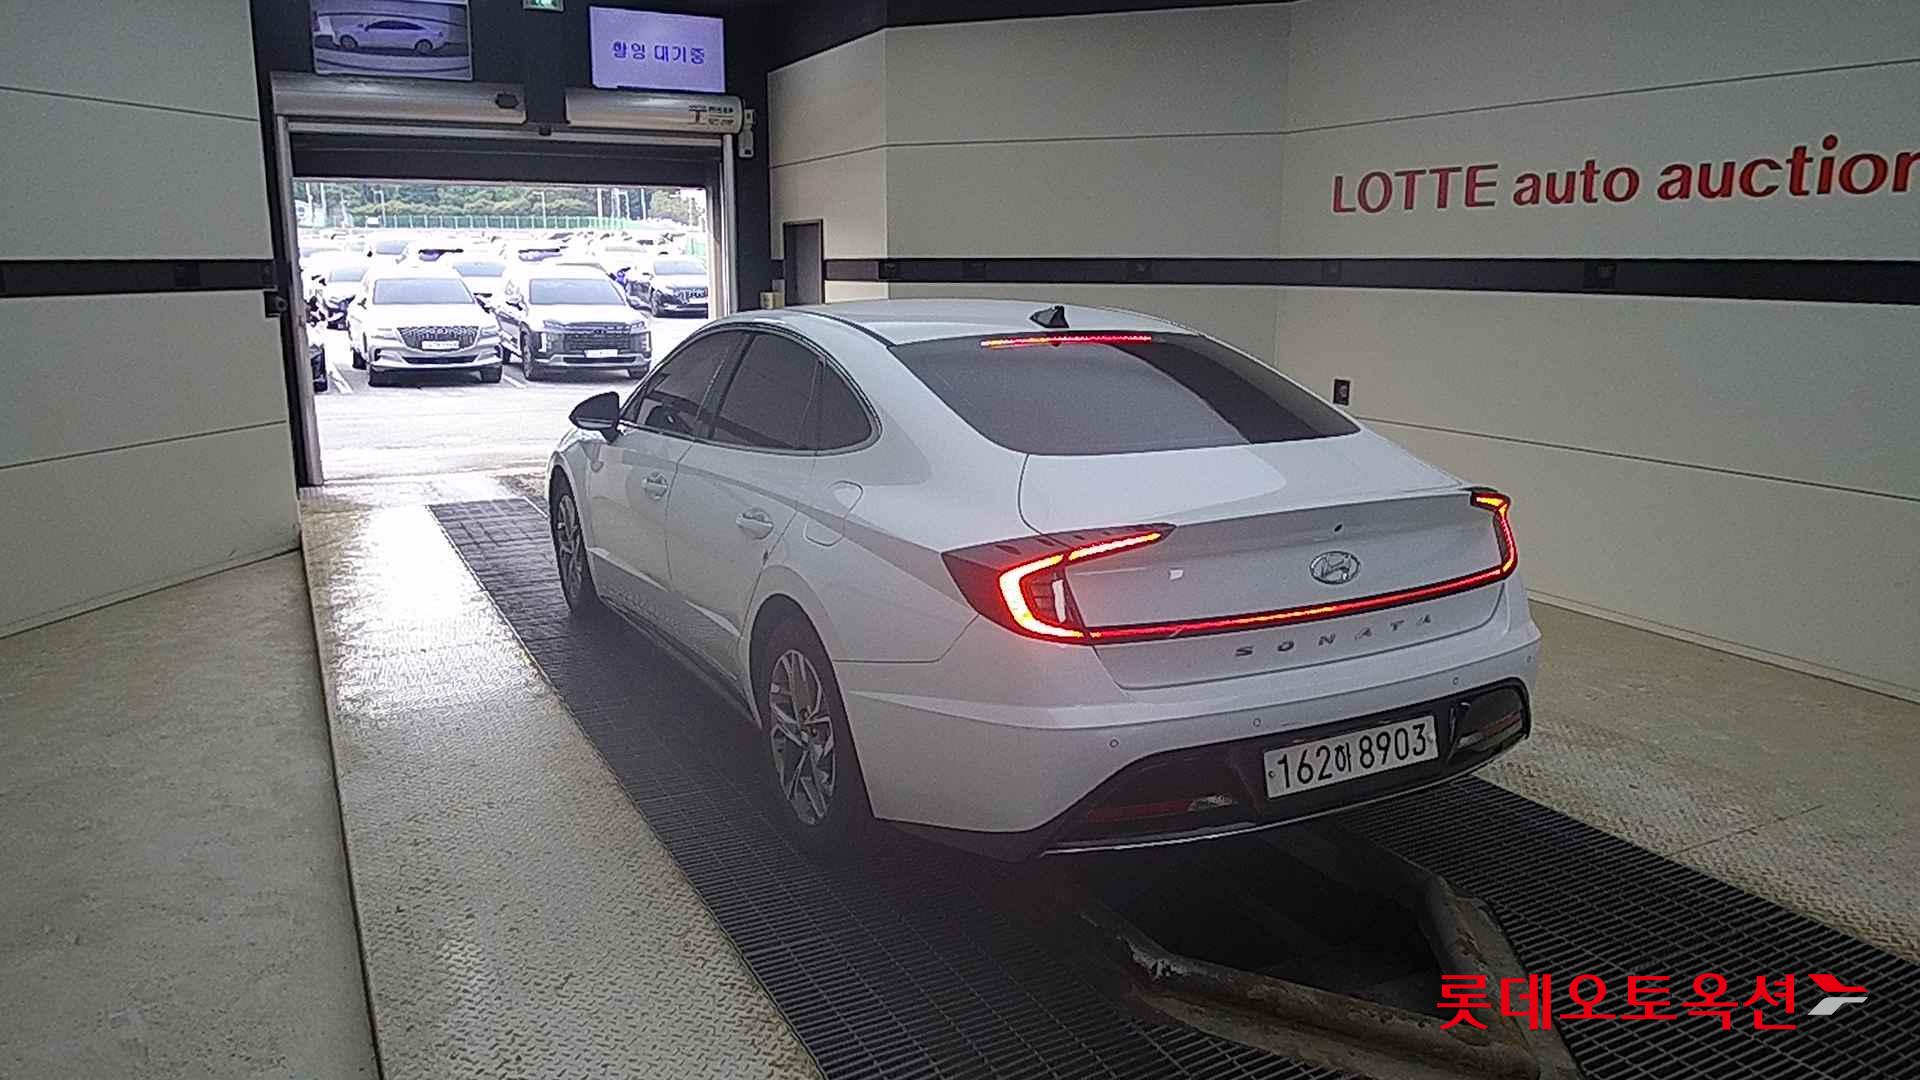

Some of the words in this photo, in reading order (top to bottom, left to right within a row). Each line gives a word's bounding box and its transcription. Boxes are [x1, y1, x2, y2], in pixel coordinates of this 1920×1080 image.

[654, 44, 705, 65] 대기중
[1331, 163, 1499, 214] LOTTE
[1512, 159, 1640, 206] auto
[1234, 614, 1432, 657] SONATA
[1359, 723, 1427, 769] 8903
